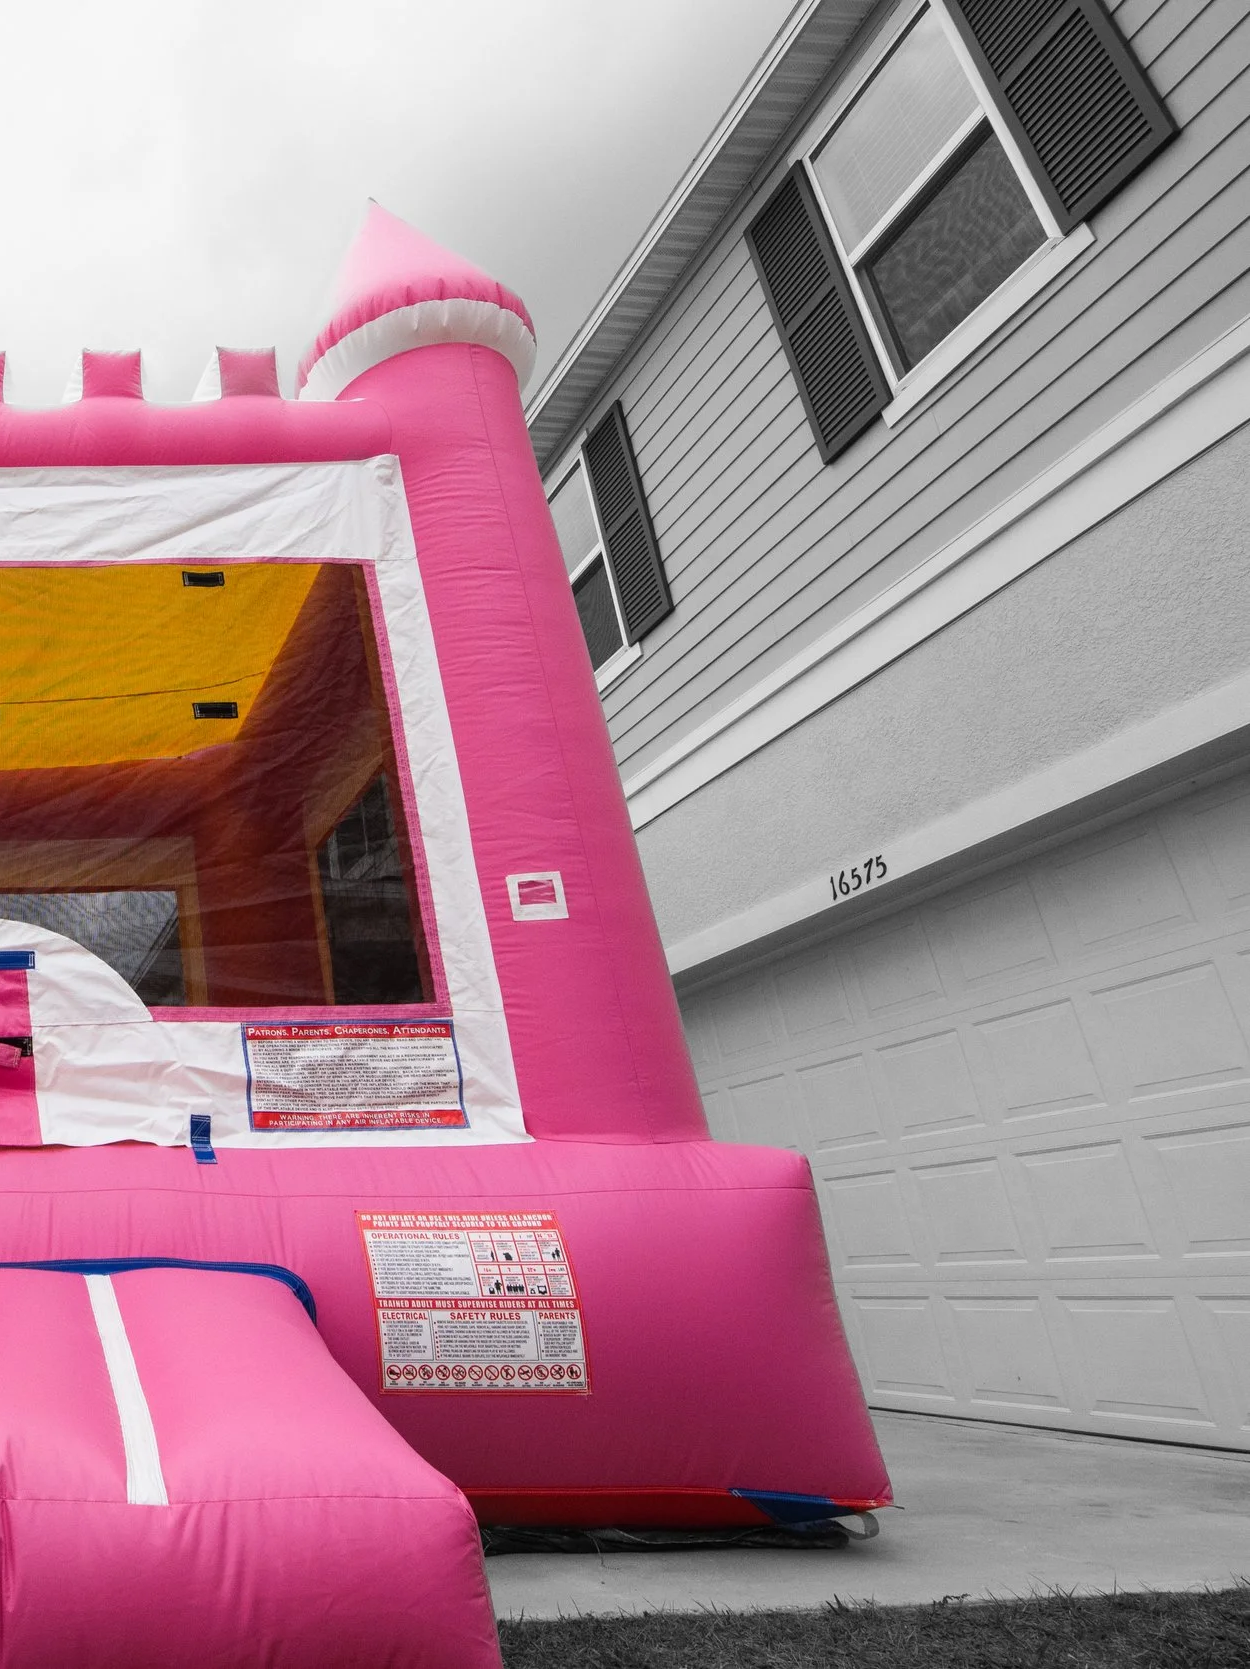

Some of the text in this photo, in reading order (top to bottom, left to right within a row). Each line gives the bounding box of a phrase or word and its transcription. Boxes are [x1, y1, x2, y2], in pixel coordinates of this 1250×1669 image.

[830, 855, 888, 901] 16575
[371, 1232, 460, 1240] OPERATIONAL RULES
[379, 1299, 575, 1309] TRAINED ADULT MUST SUPERVISE RIDERS AT ALL TIMES
[382, 1312, 428, 1320] ELECTRICAL
[450, 1312, 521, 1321] SAFETY RULES
[538, 1312, 576, 1321] PARENTS
